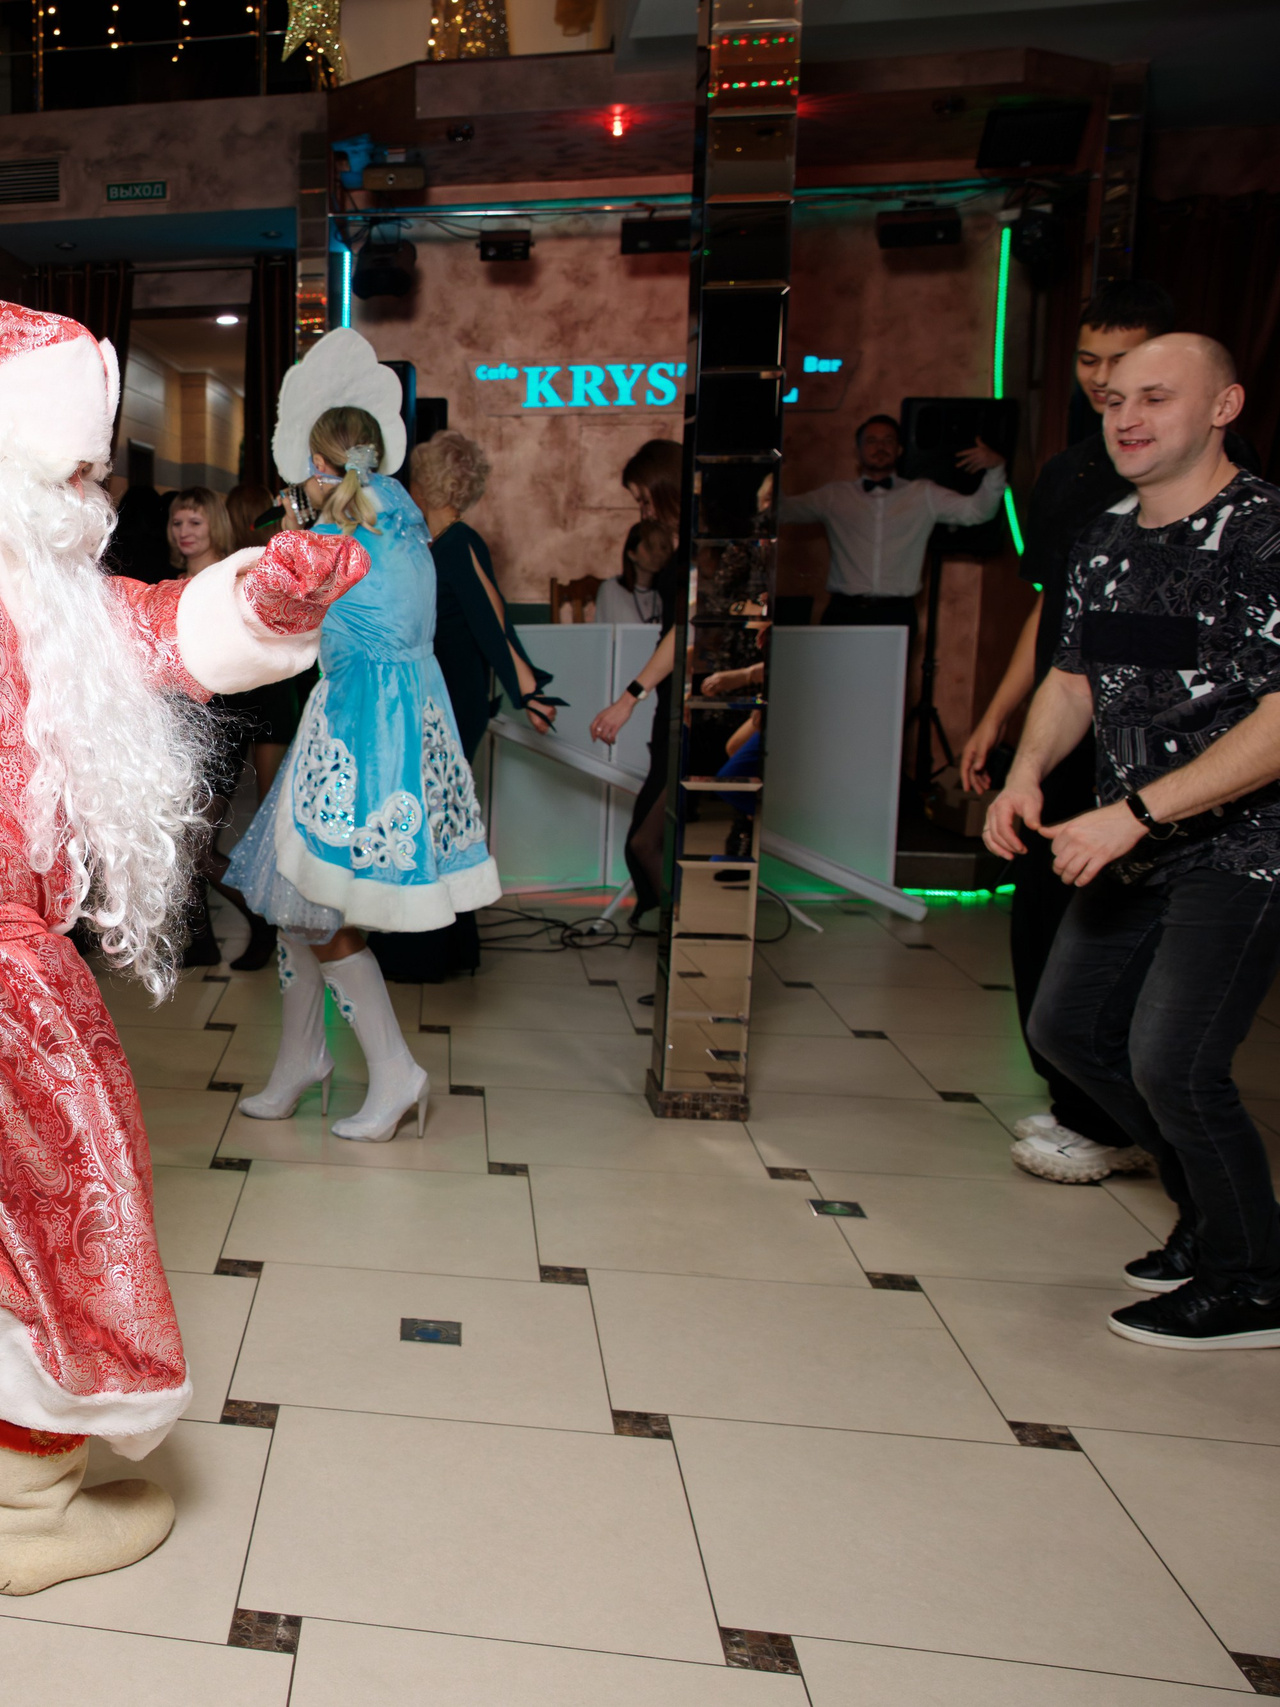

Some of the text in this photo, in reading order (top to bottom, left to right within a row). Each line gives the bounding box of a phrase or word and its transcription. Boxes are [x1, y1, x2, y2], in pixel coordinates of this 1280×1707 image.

[110, 184, 163, 199] ВЫХОД
[475, 356, 843, 408] Cafe KRYS Bar
